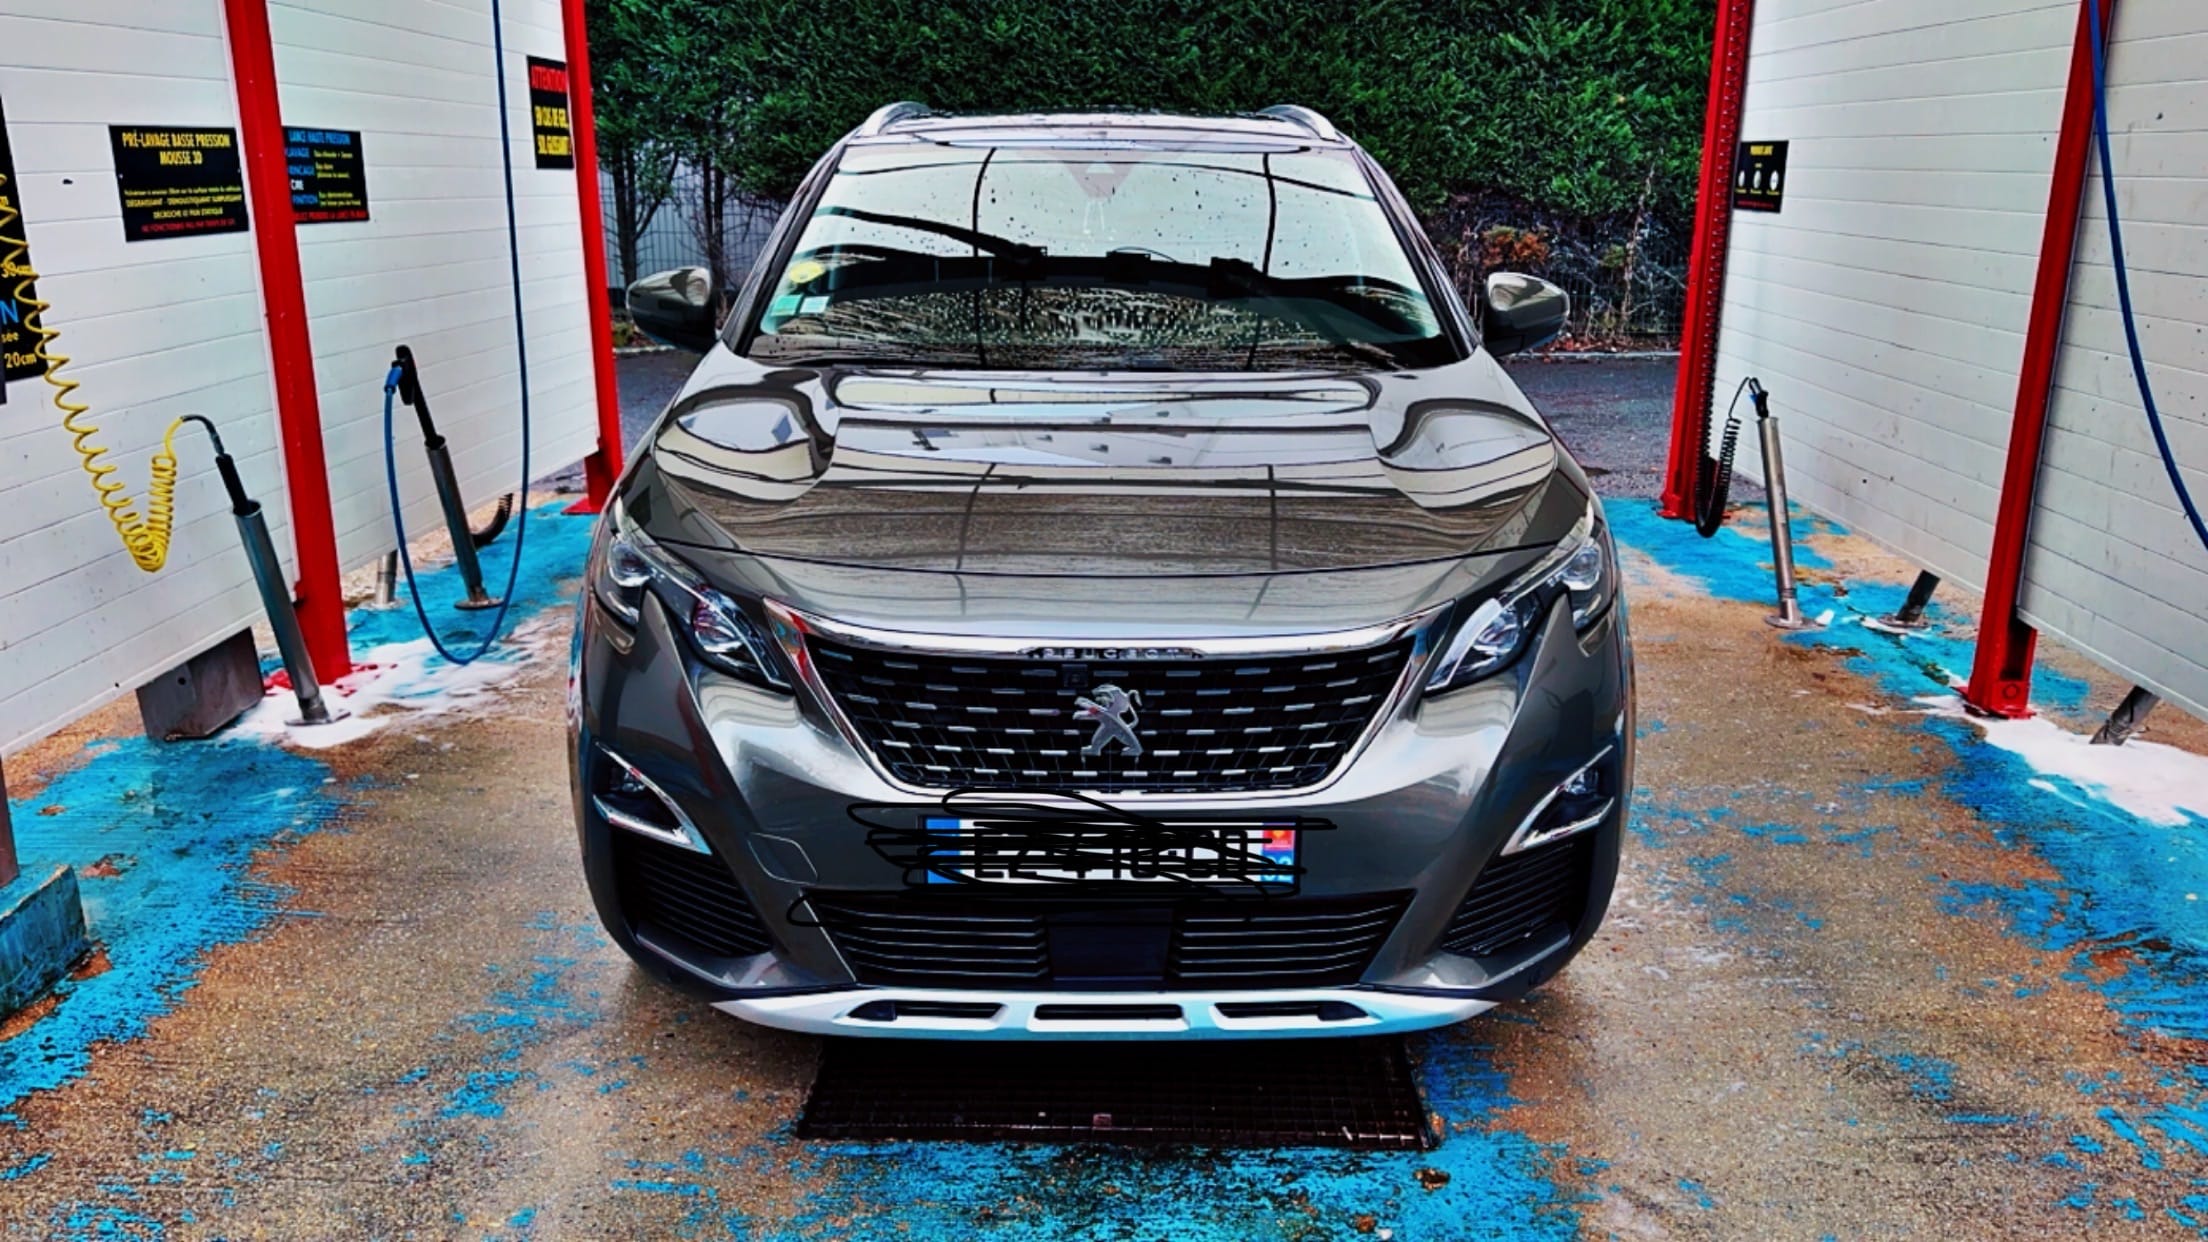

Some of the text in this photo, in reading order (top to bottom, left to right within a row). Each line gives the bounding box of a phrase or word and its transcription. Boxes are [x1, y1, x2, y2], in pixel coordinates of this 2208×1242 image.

[171, 133, 195, 147] BASSE
[195, 133, 231, 147] PRESSION
[160, 151, 192, 165] MOUSSE
